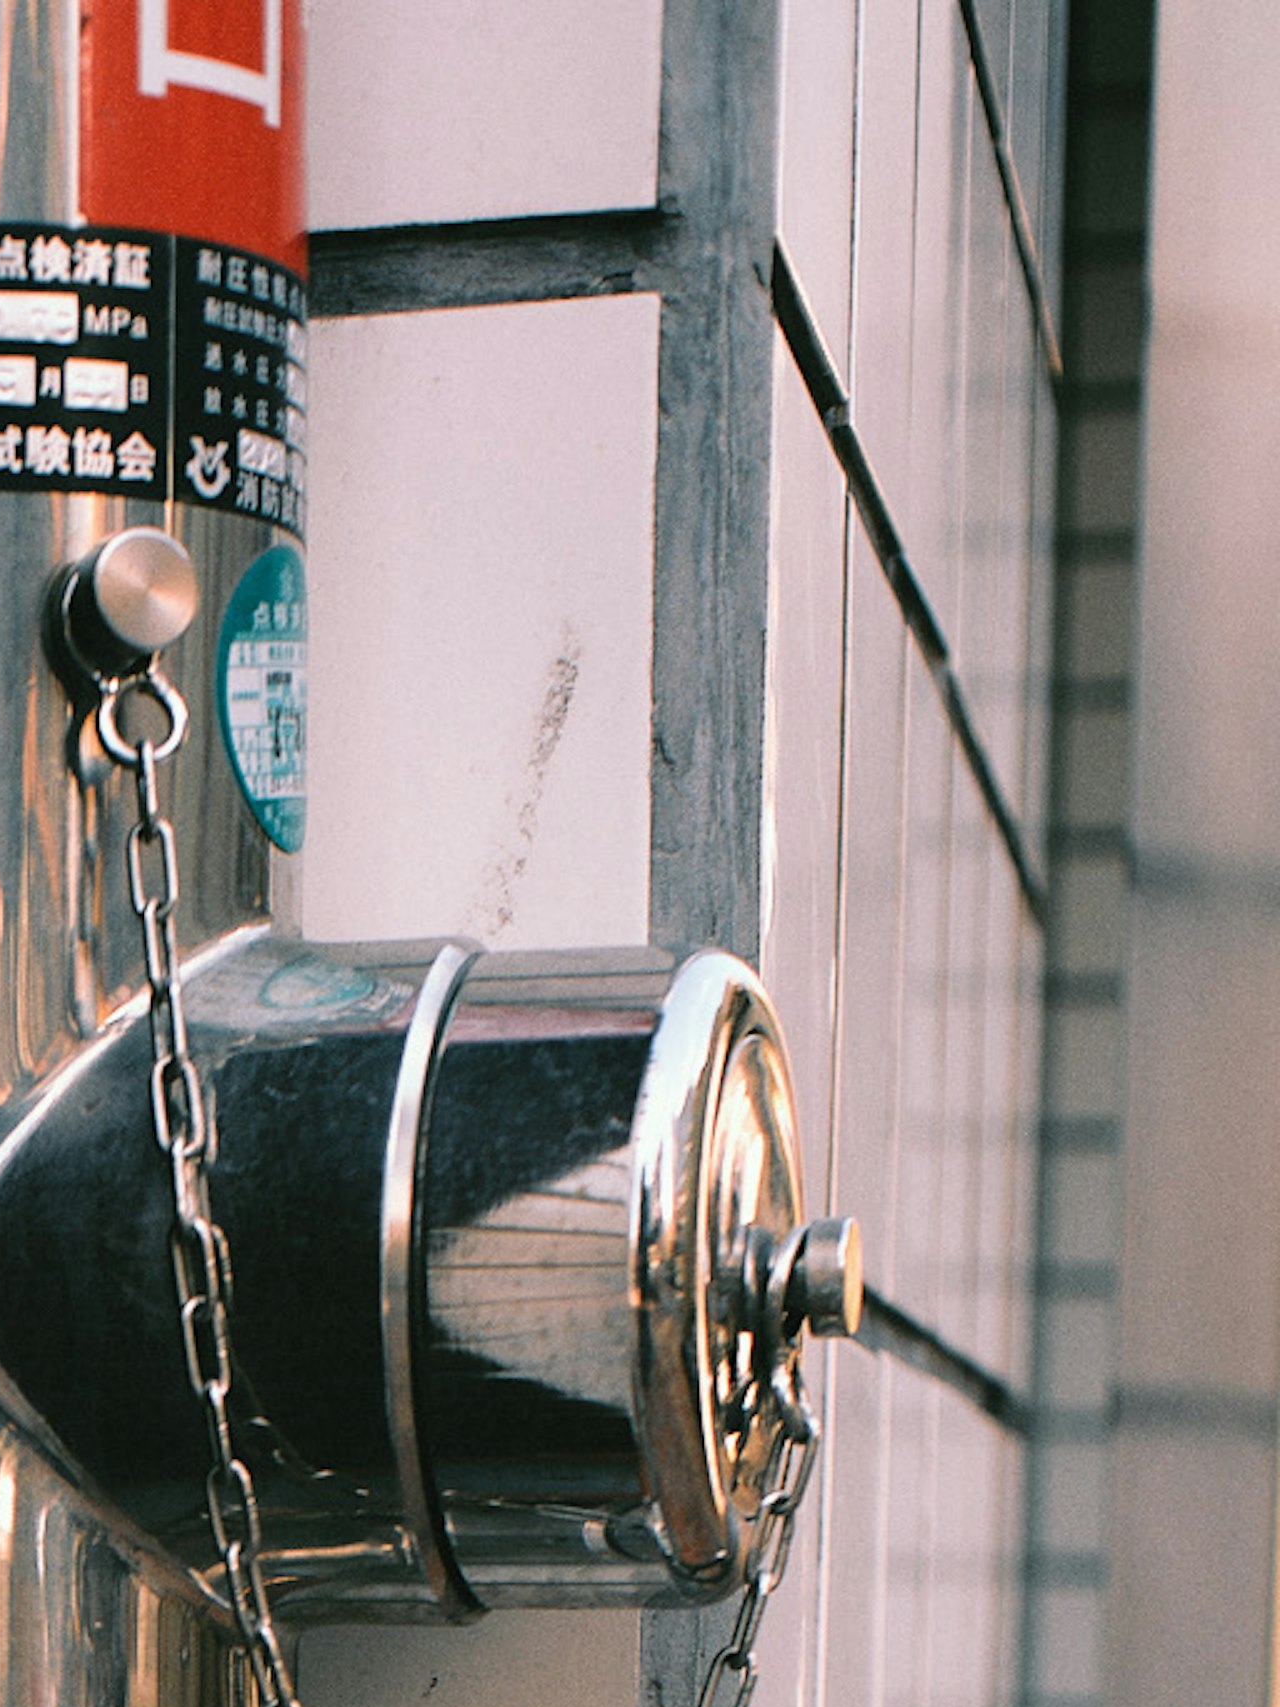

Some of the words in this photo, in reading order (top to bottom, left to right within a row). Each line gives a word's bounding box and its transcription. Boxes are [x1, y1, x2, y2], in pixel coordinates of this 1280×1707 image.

[84, 303, 149, 340] MPa
[40, 365, 63, 398] 月
[130, 373, 150, 405] 日
